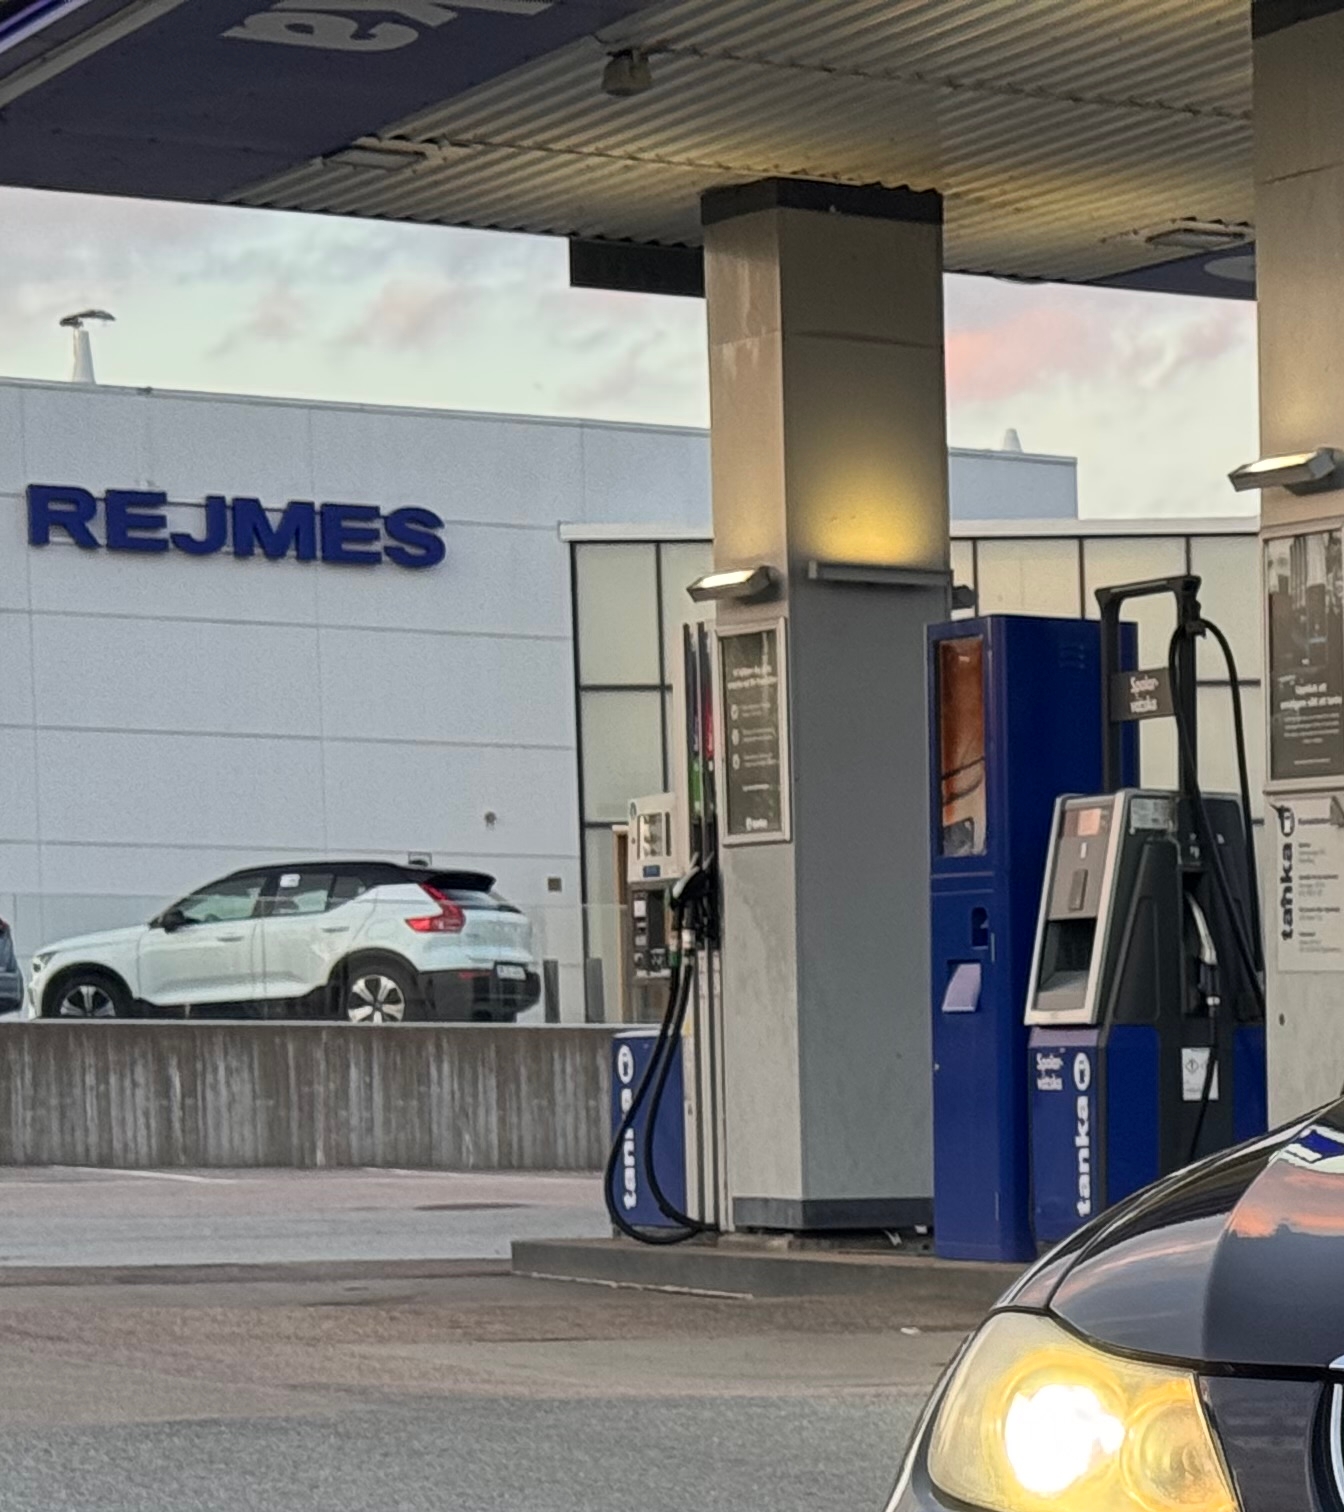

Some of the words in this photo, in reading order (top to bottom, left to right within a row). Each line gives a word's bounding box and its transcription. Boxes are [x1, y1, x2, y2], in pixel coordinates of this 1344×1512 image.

[26, 483, 447, 568] REJMES
[1280, 842, 1294, 941] tanka
[1075, 1095, 1091, 1218] tanka
